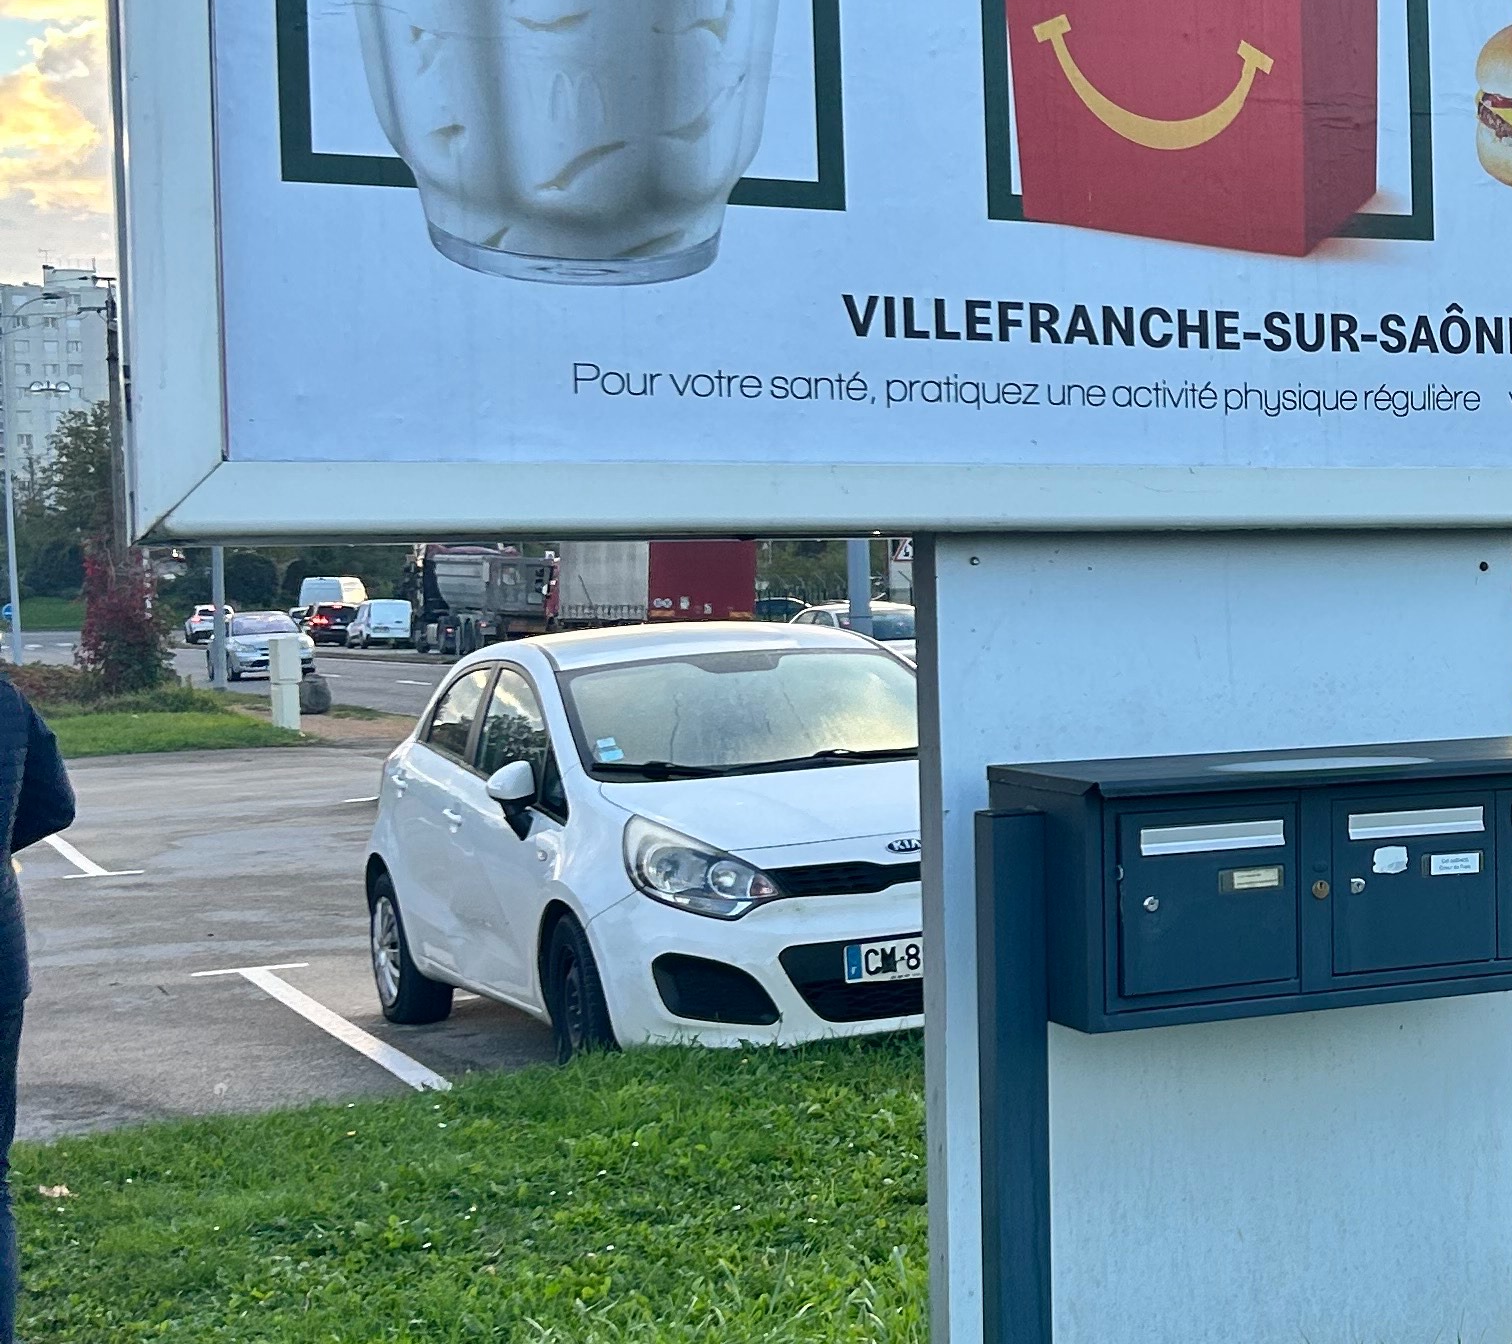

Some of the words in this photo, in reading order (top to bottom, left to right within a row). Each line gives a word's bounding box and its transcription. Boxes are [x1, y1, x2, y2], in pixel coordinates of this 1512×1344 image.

[573, 362, 662, 396] Pour
[670, 369, 762, 399] votre
[771, 371, 876, 405] santé,
[886, 373, 1040, 411] pratiquez
[1048, 383, 1106, 407] une
[1113, 380, 1217, 410] activité
[1225, 381, 1358, 418] physique
[1365, 383, 1481, 418] régulière
[892, 838, 922, 852] KIA
